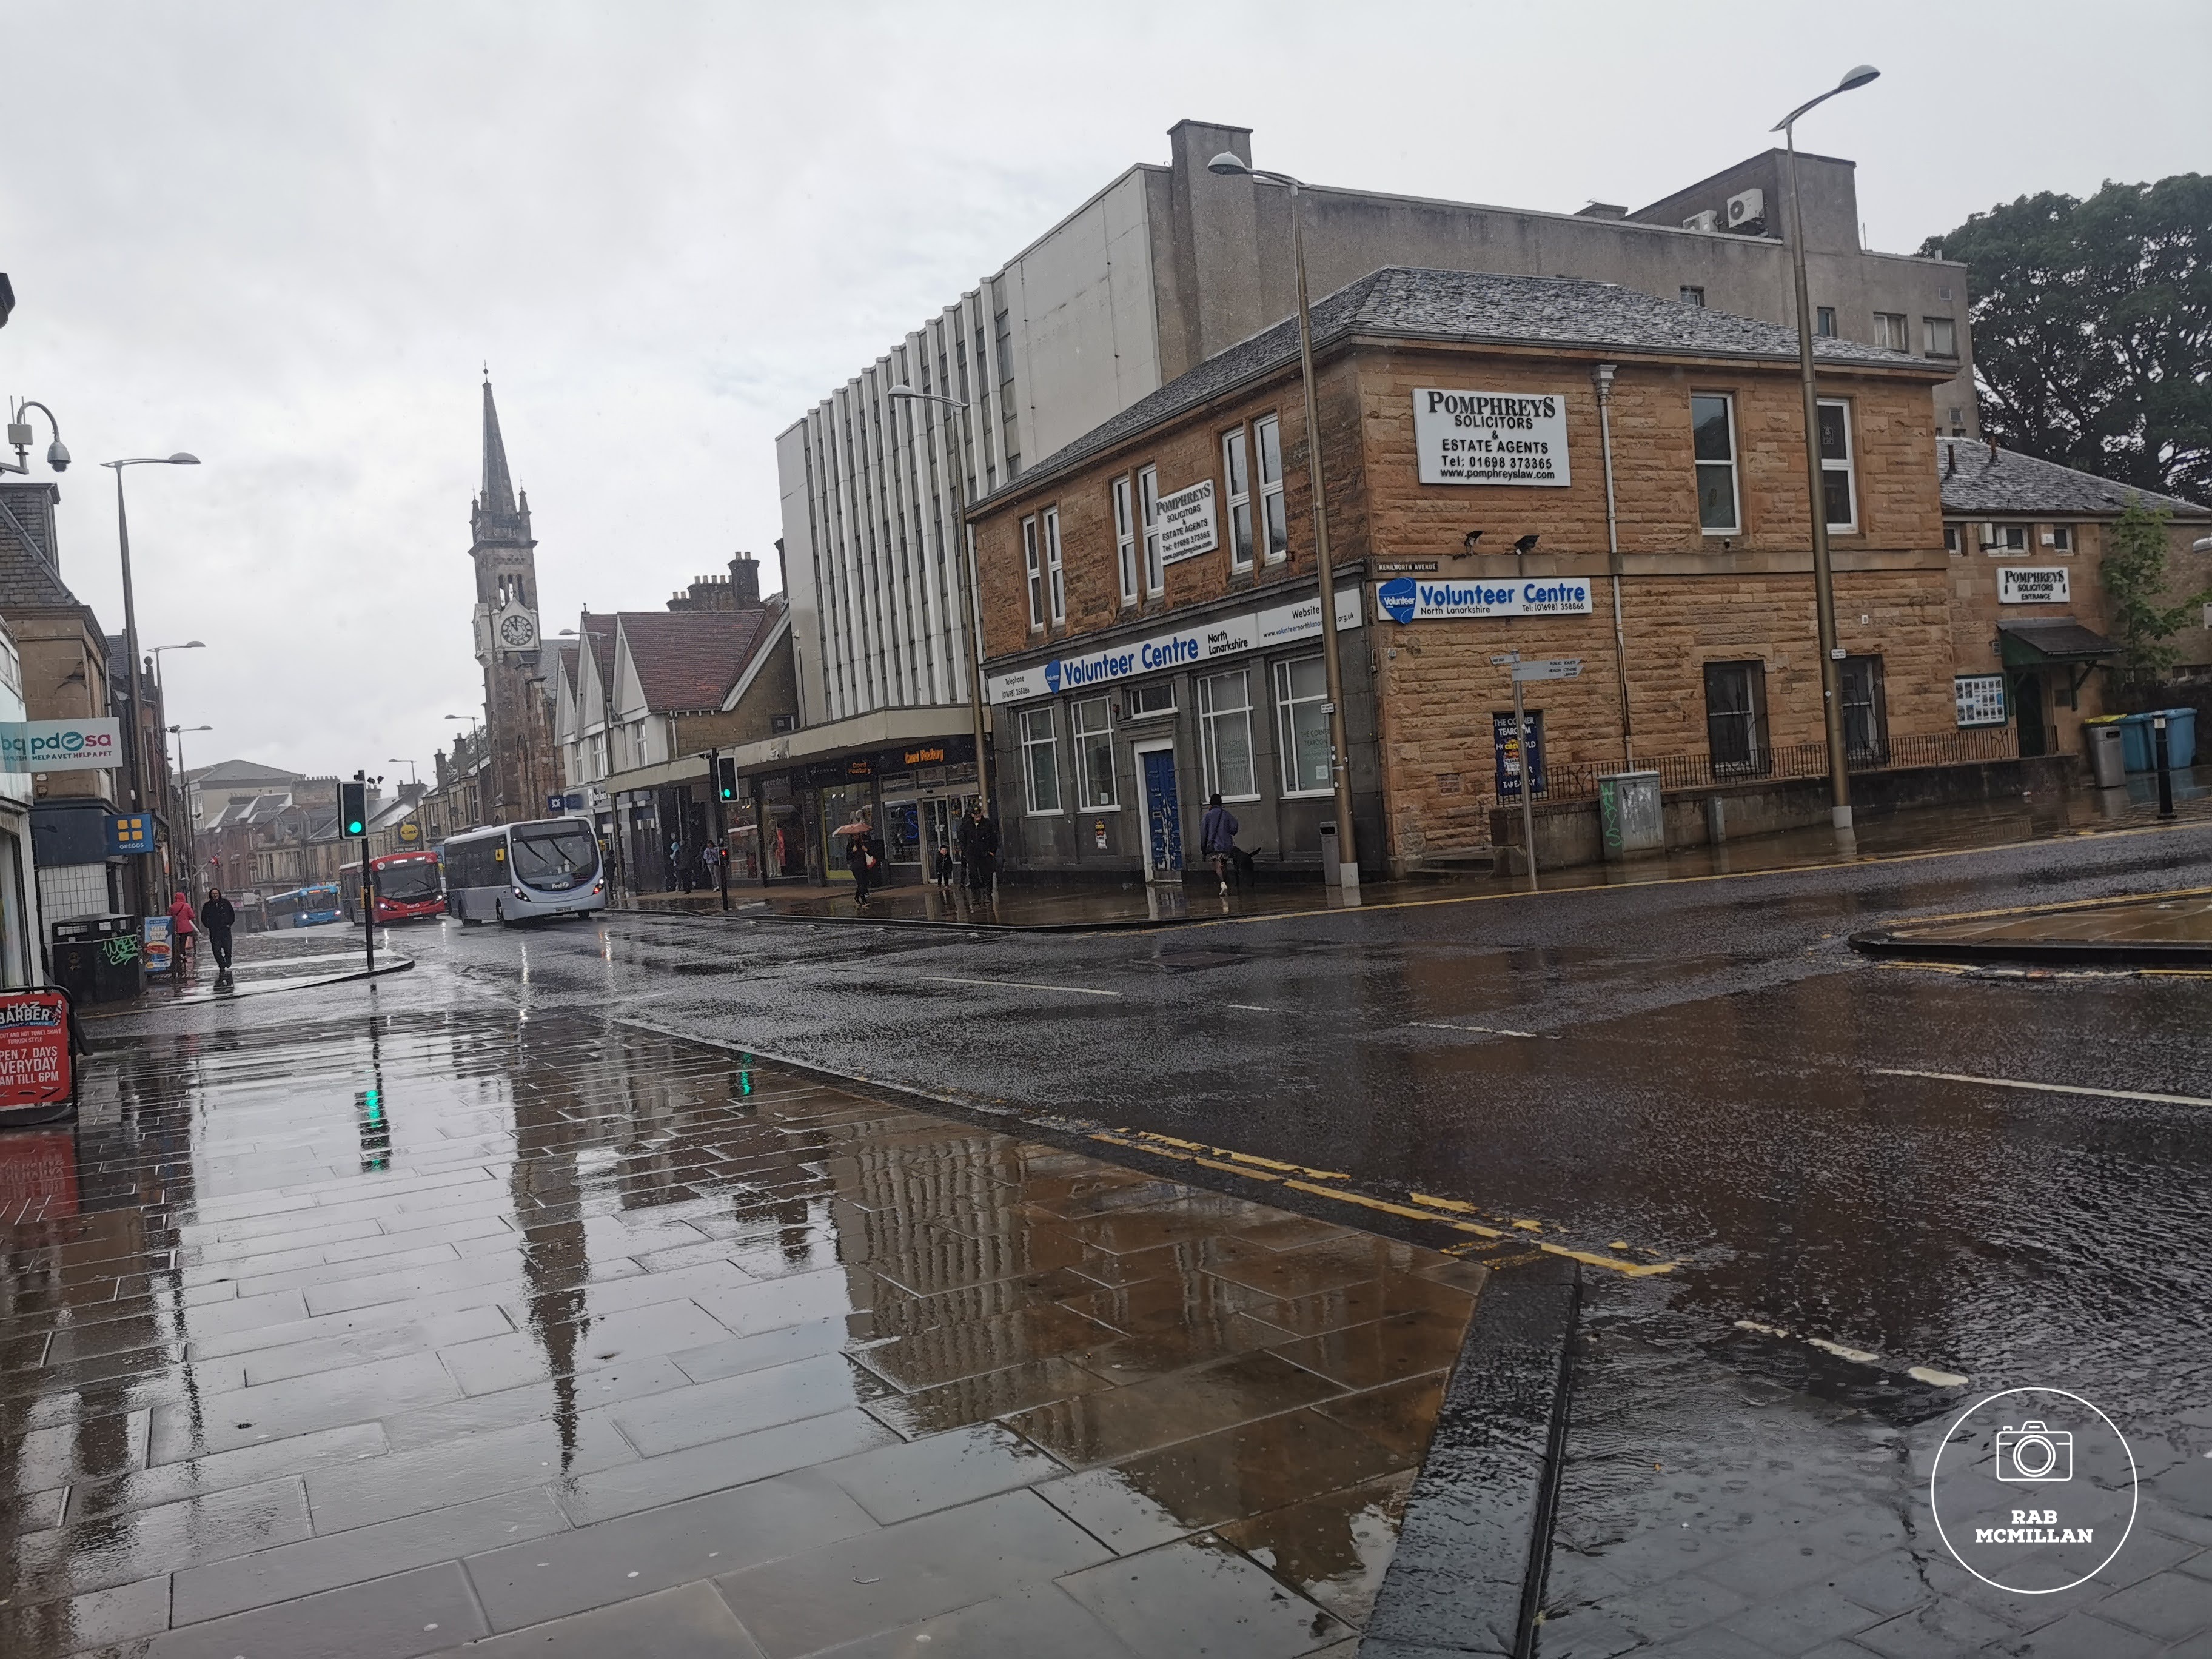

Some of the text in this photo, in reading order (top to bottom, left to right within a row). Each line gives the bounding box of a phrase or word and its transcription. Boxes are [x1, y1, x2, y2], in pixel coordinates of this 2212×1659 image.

[1455, 415, 1533, 430] SOLICITORS
[1492, 430, 1499, 440] &
[1442, 439, 1549, 454] ESTATE AGENTS
[1441, 455, 1552, 469] Tel: 01698 373365
[1440, 469, 1555, 481] www.pomphreyslaw.com
[1167, 504, 1201, 523] SOLICITORS
[1162, 518, 1208, 541] ESTATE AGENTS
[1420, 583, 1585, 606] Volunteer Centre
[2017, 583, 2054, 592] SOLICITORS
[1384, 596, 1415, 605] Volunteer
[2021, 592, 2051, 601] ENTRANCE
[1292, 605, 1320, 619] Website
[1208, 630, 1228, 644] North
[1208, 638, 1248, 655] Lanarkshire
[1064, 637, 1199, 686] Volunteer Centre
[1005, 675, 1025, 686] Telephone
[1494, 718, 1507, 727] THE
[7, 1001, 41, 1011] HAZ
[0, 1046, 58, 1061] PEN 7 DAYS
[0, 1057, 58, 1074] VERYDAY
[0, 1071, 59, 1086] AM TILL 6PM
